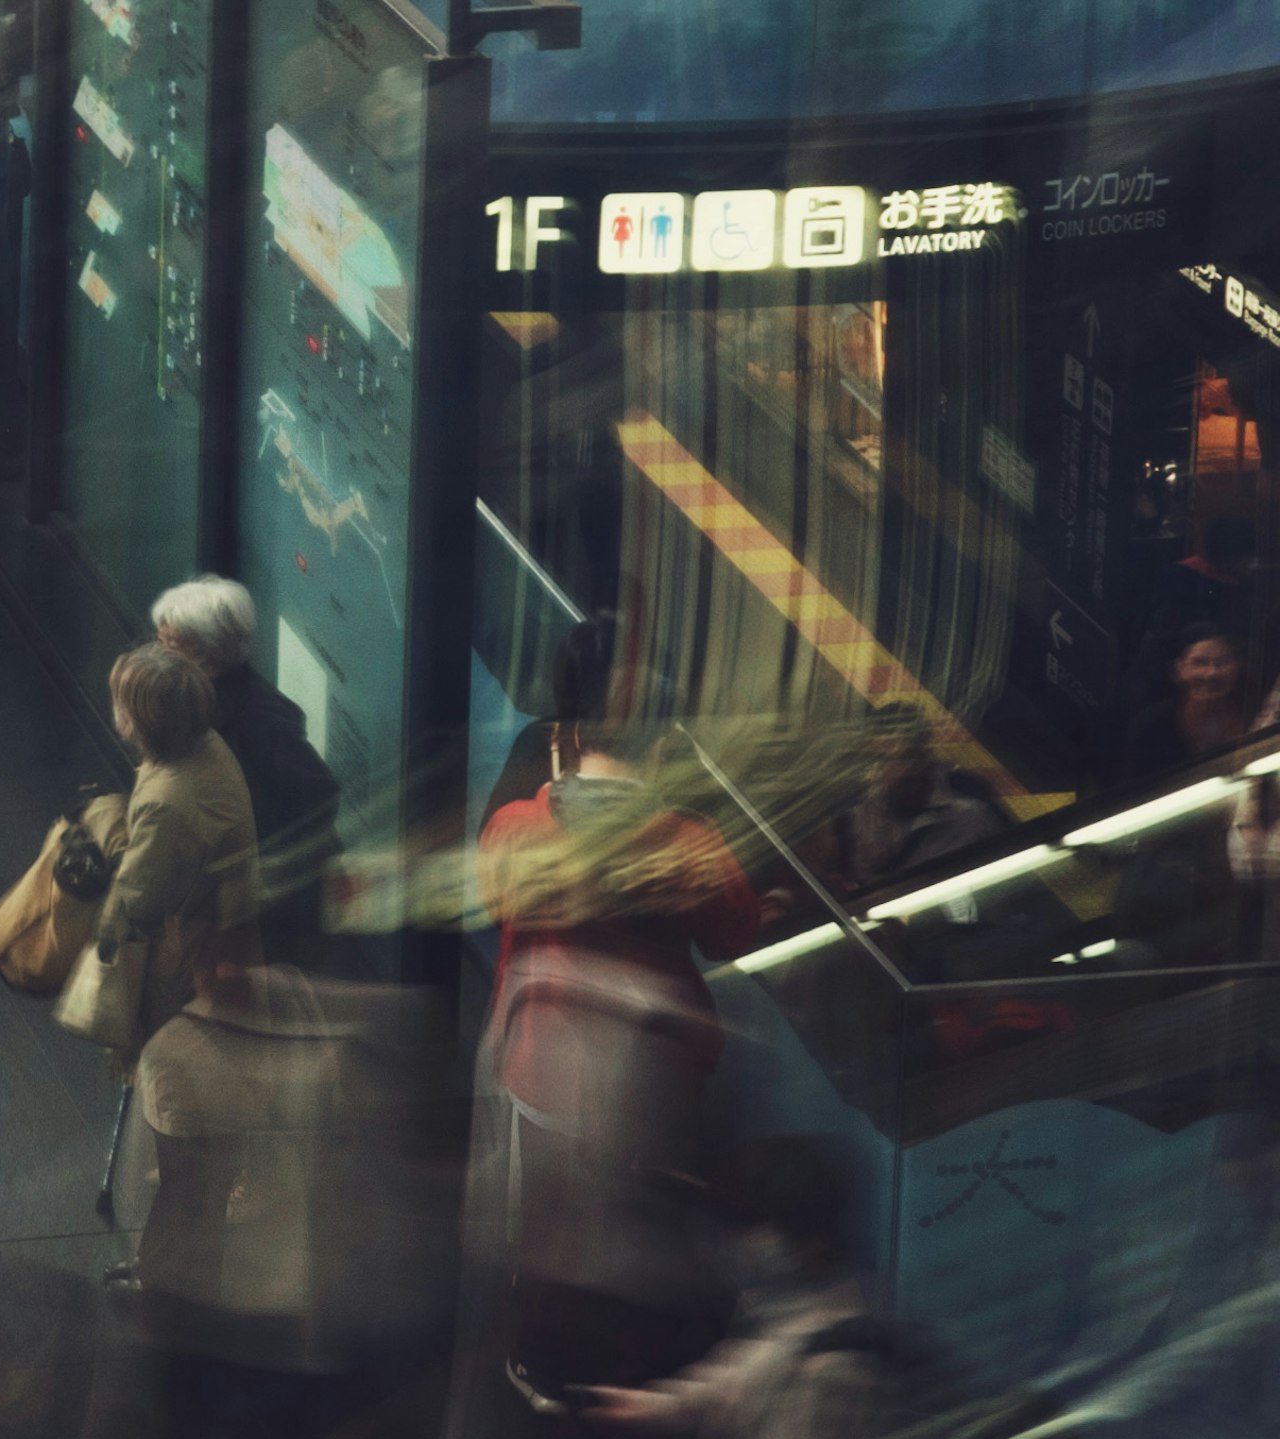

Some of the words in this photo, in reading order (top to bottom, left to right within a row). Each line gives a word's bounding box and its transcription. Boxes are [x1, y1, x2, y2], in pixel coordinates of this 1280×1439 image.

[879, 182, 1004, 230] お手洗
[1043, 167, 1170, 211] コインロッカー
[485, 196, 565, 272] 1F
[877, 230, 986, 258] LAVATORY
[1042, 218, 1085, 241] COIN
[1089, 208, 1167, 237] LOCKERS
